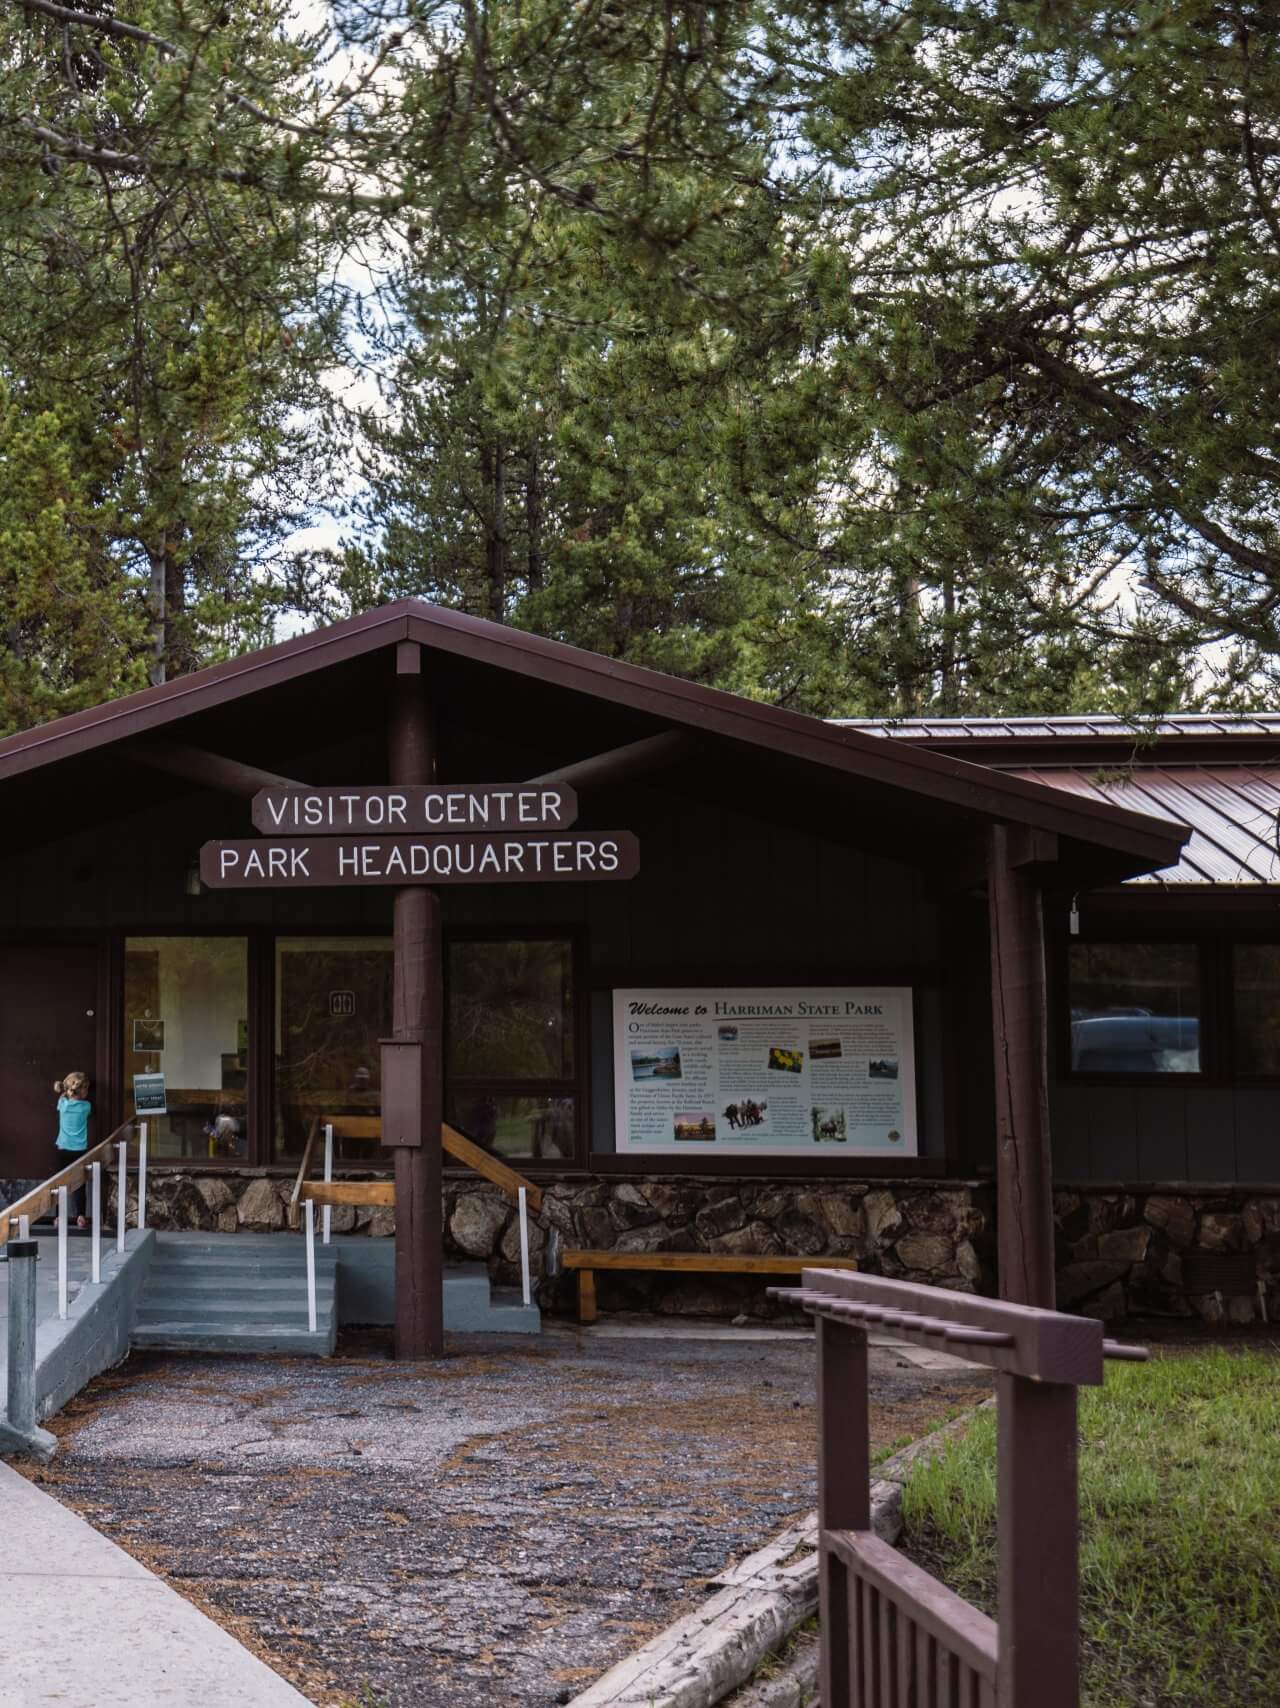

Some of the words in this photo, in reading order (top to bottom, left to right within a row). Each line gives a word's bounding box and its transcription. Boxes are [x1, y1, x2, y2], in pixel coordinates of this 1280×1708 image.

[266, 794, 408, 825] VISITOR
[424, 791, 562, 824] CENTER
[220, 847, 311, 878] PARK
[338, 841, 619, 877] HEADQUARTERS
[628, 1001, 690, 1016] Welcome
[694, 1004, 708, 1015] to
